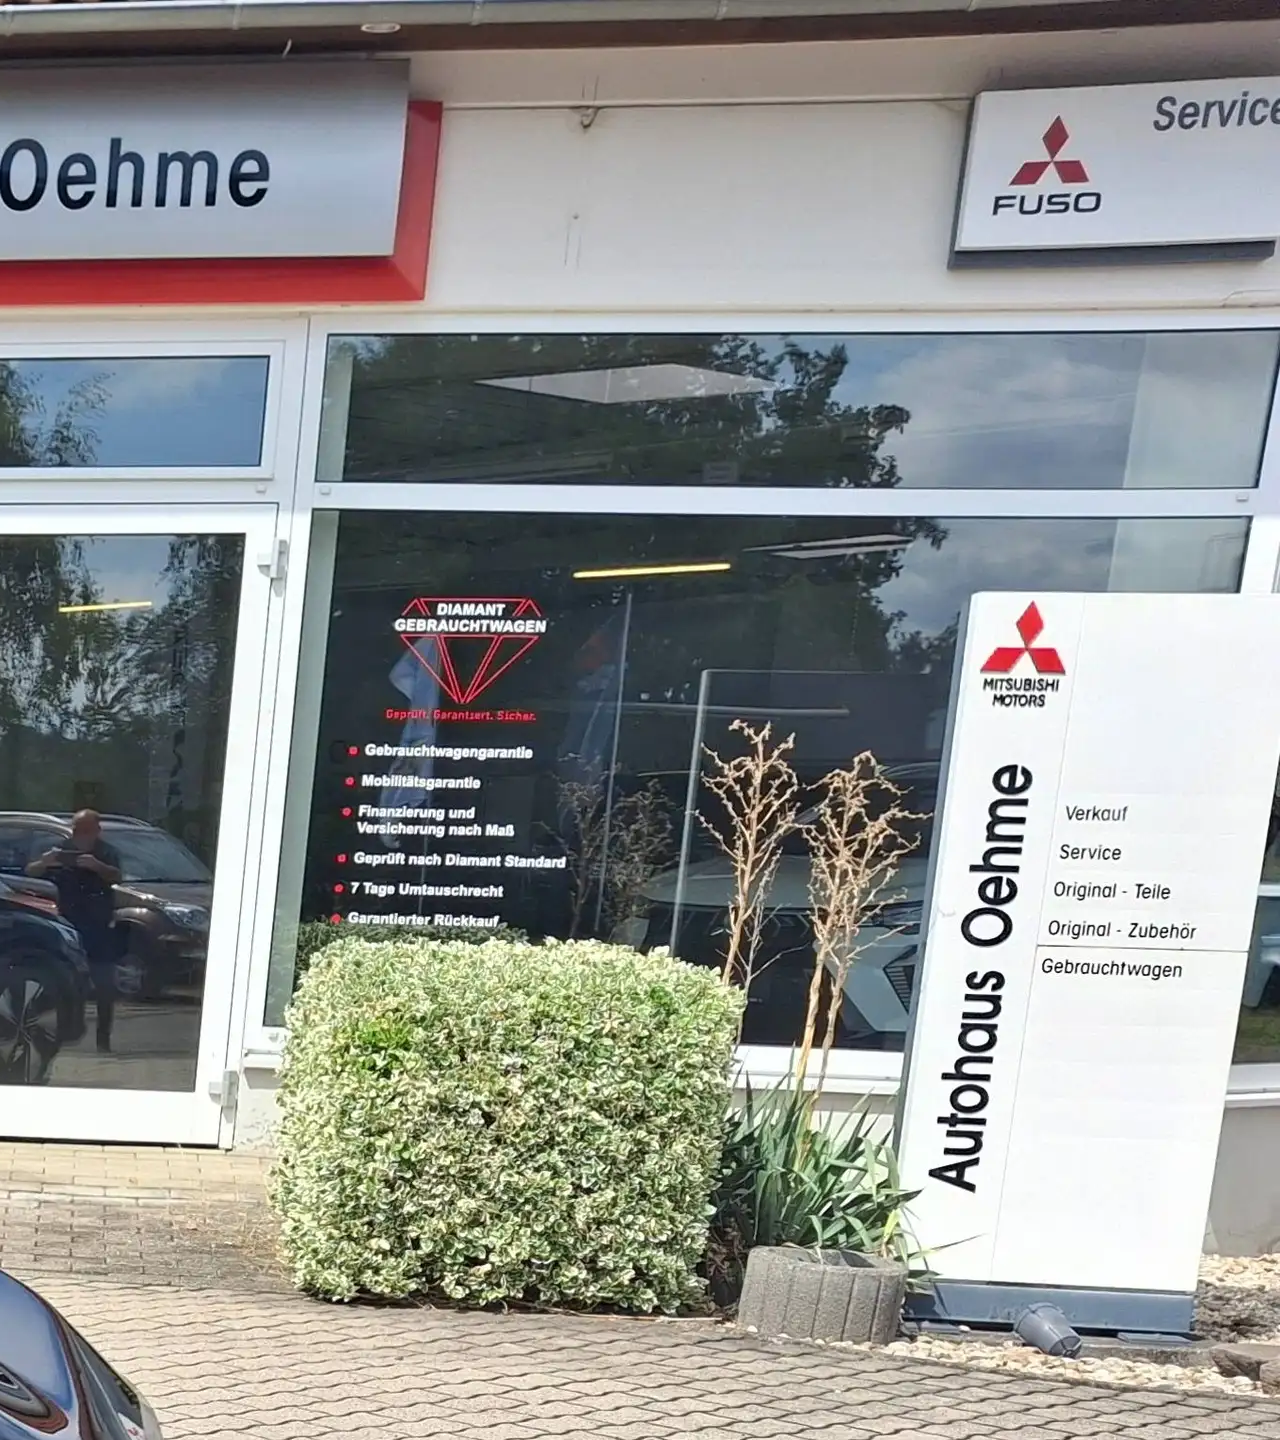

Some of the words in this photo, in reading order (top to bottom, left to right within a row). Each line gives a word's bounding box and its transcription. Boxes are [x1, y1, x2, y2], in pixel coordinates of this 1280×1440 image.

[1153, 91, 1280, 131] Service
[992, 192, 1102, 215] FUSO
[436, 603, 506, 616] DIAMANT
[394, 618, 547, 633] GEBRAUCHTWAGEN
[983, 678, 1060, 693] MITSUBISHI
[992, 694, 1046, 708] MOTORS
[497, 710, 537, 721] Sicher.
[365, 744, 534, 760] Gebrauchtwagengarantie
[361, 774, 481, 791] Mobilitätsgarantie
[358, 805, 445, 820] Finanzierung
[448, 807, 476, 819] und
[1066, 805, 1129, 821] Verkauf
[357, 822, 445, 837] Versicherung
[448, 824, 482, 837] nach
[485, 824, 515, 837] Maß
[354, 851, 406, 867] Geprüft
[408, 853, 442, 866] nach
[445, 854, 502, 867] Diamant
[504, 855, 567, 869] Standard
[961, 764, 1033, 948] Oehme
[1059, 844, 1122, 860] Service
[351, 881, 360, 894] 7
[363, 882, 395, 898] Tage
[399, 883, 504, 898] Umtauschrecht
[1054, 881, 1117, 901] Original
[1135, 883, 1172, 900] Teile
[348, 912, 431, 926] Garantierter
[434, 913, 500, 928] Rückkauf
[1048, 920, 1111, 939] Original
[1128, 922, 1198, 939] Zubehör
[1041, 958, 1183, 981] Gebrauchtwagen
[928, 970, 1006, 1194] Autohaus
